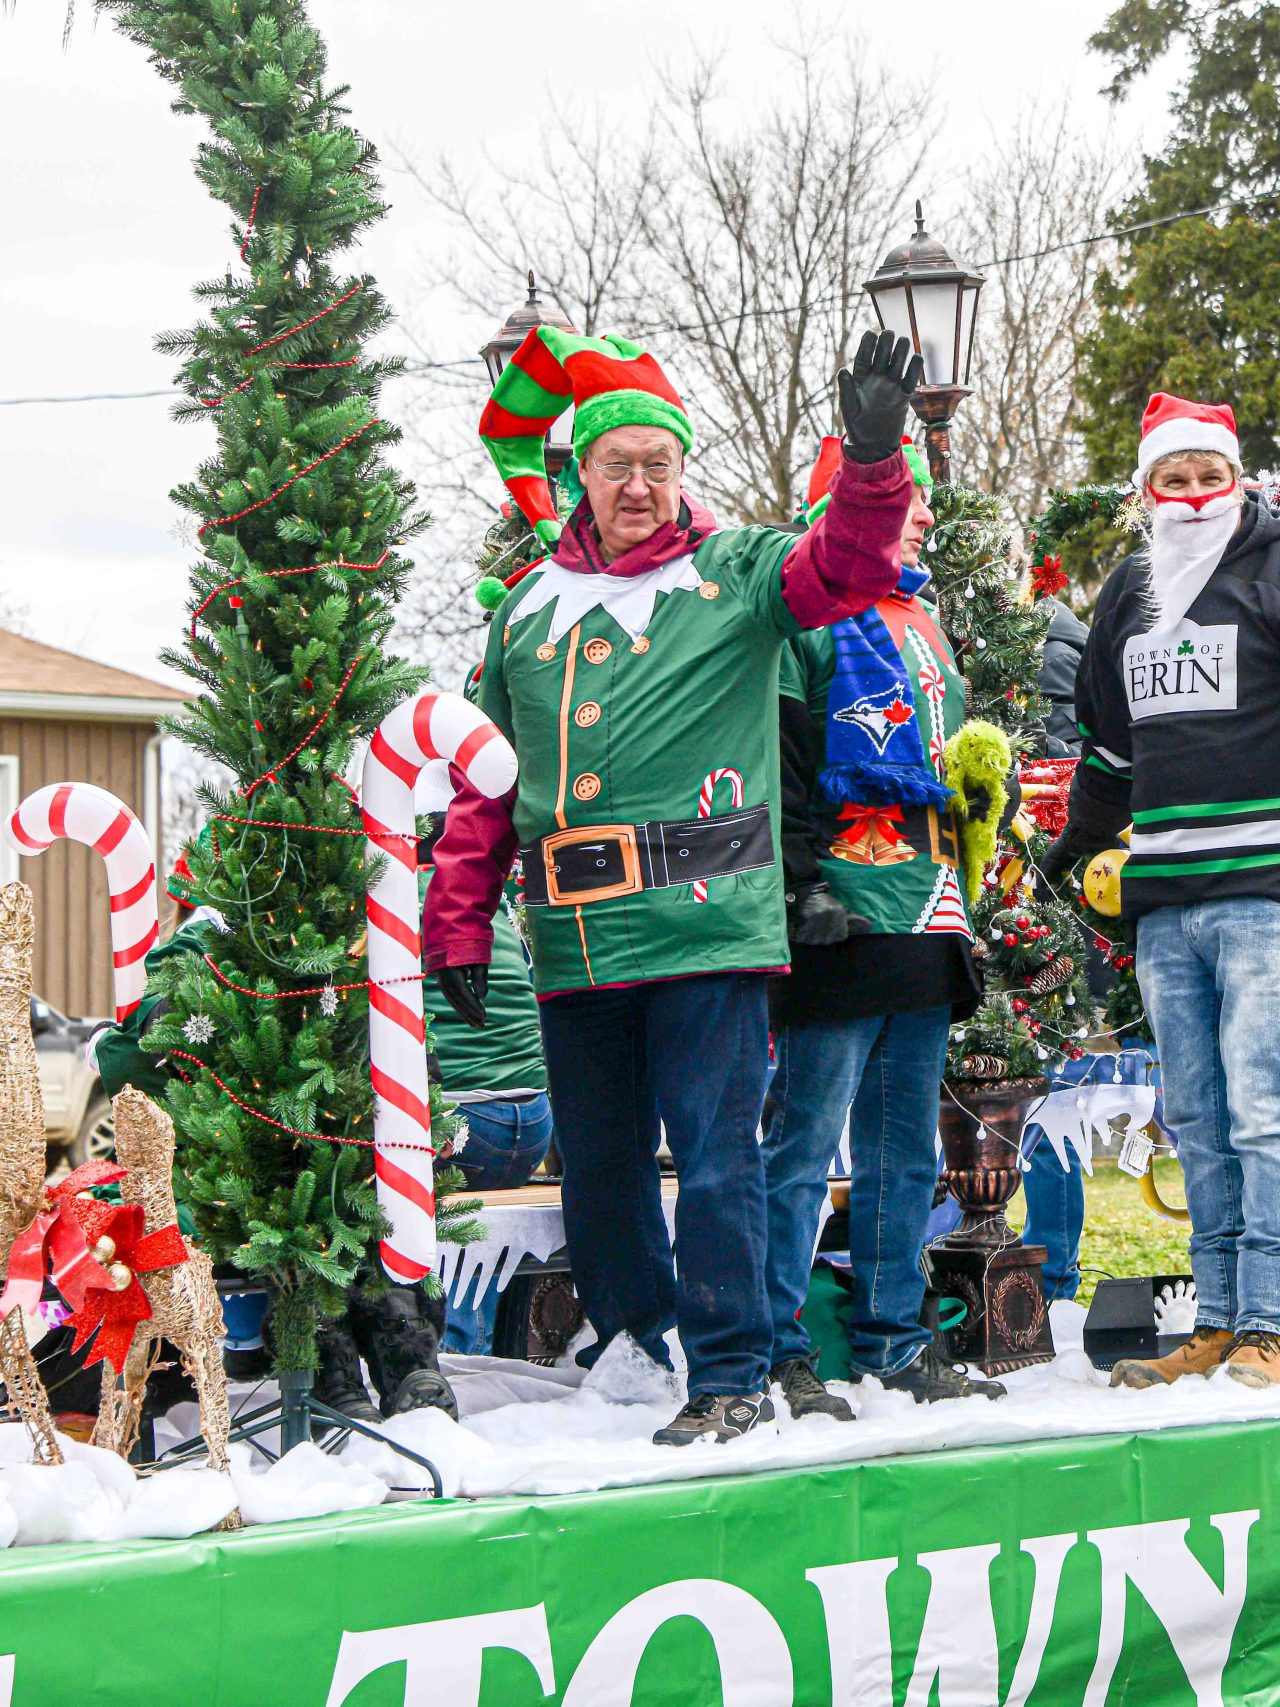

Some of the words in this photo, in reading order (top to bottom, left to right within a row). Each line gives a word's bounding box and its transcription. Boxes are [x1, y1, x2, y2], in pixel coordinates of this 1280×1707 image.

[1128, 648, 1172, 665] TOWN
[1200, 643, 1224, 655] OF
[1129, 657, 1223, 703] ERIN
